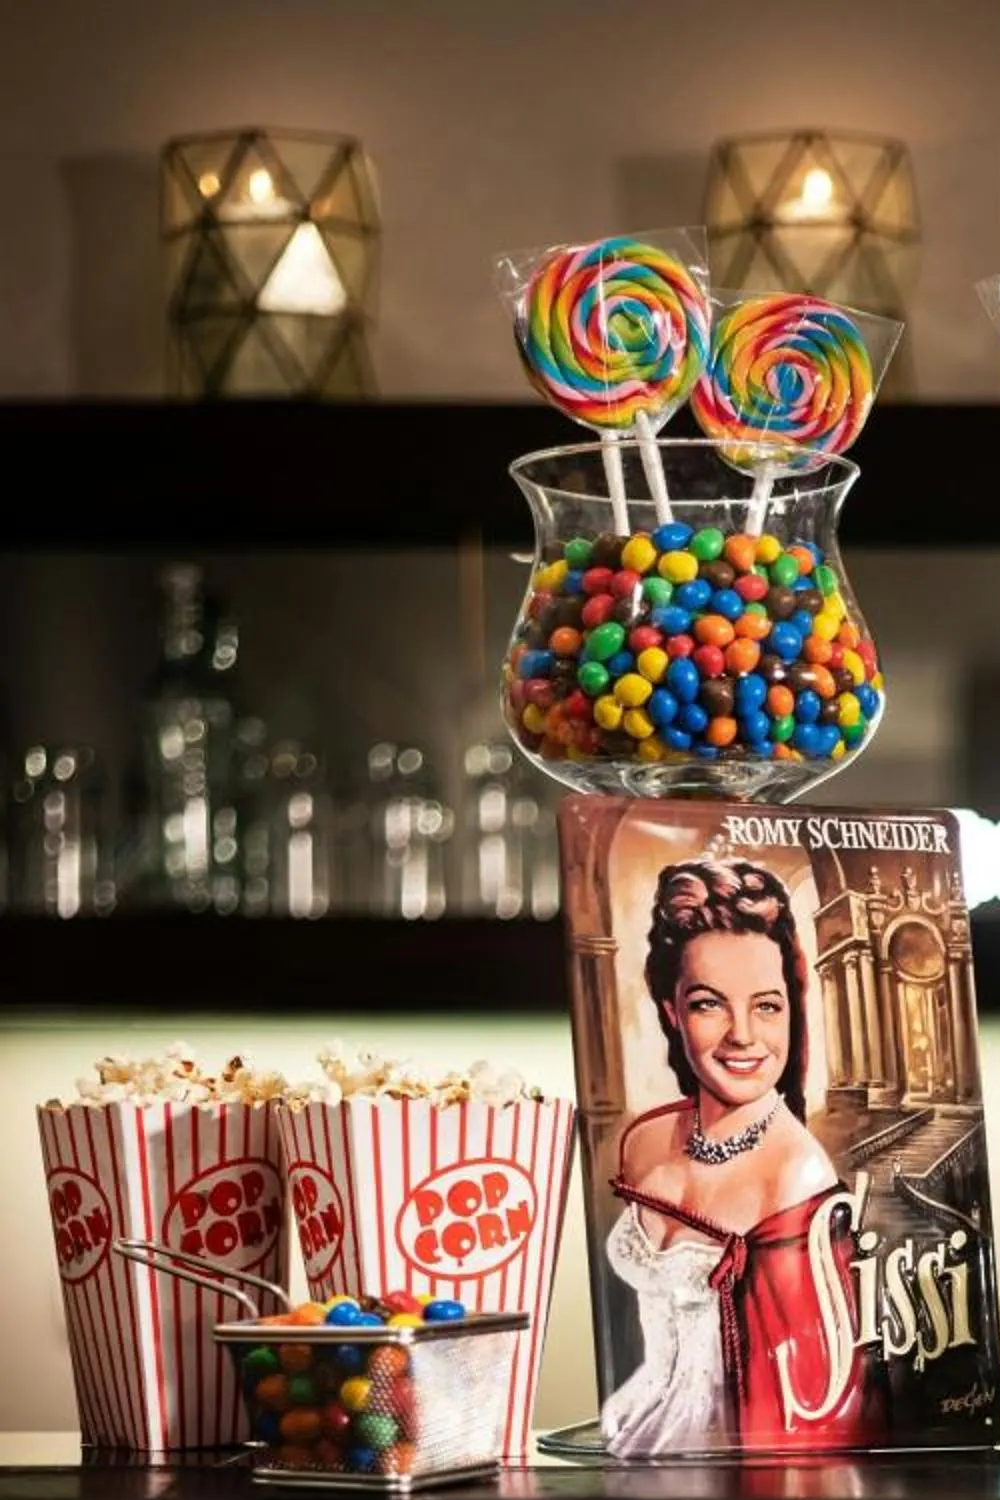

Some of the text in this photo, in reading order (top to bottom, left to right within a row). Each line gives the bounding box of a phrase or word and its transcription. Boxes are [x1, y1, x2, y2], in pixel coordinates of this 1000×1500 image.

[725, 815, 951, 854] ROMY SCHNEIDER
[51, 1179, 82, 1224] OP
[179, 1170, 265, 1228] POP
[292, 1175, 318, 1219] OP
[414, 1171, 509, 1227] POP
[55, 1207, 109, 1263] ORN
[180, 1197, 281, 1258] CORN
[299, 1203, 341, 1260] ORN
[414, 1200, 531, 1265] CORN
[775, 1172, 977, 1432] Sissi
